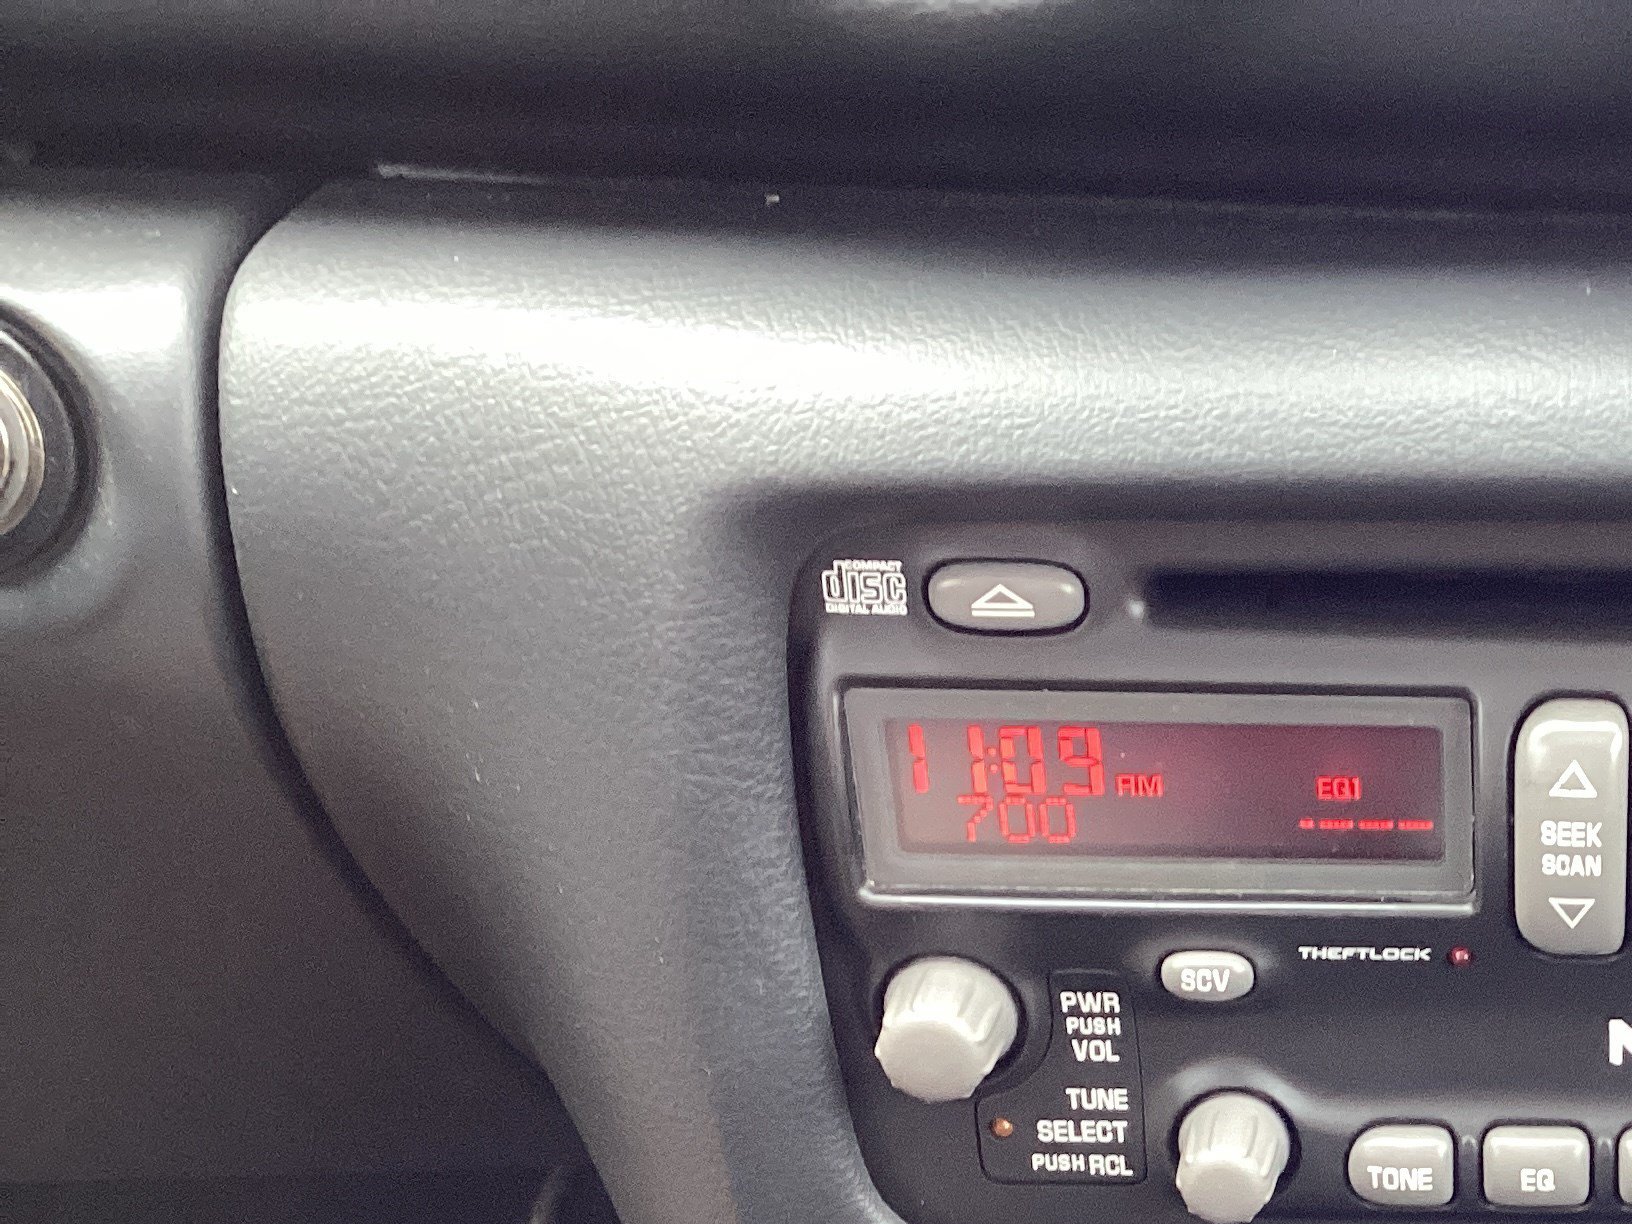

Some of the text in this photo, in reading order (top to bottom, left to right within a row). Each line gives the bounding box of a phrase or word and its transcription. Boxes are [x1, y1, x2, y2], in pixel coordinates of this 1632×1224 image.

[844, 559, 903, 571] COMPACT
[825, 604, 908, 616] DIGITAL AUDIO
[1115, 774, 1164, 798] AM
[1315, 776, 1361, 800] EQ1
[958, 795, 1077, 844] 700
[1541, 821, 1603, 848] SEEK
[1541, 854, 1602, 877] SCAN
[1297, 945, 1431, 963] THEFTLOCK
[1179, 967, 1231, 993] SCV
[1060, 991, 1121, 1015] PWR
[1065, 1016, 1121, 1038] PUSH
[1071, 1038, 1120, 1063] VOL
[1065, 1086, 1129, 1112] TUNE
[1036, 1119, 1128, 1144] SELECT
[1031, 1152, 1134, 1176] PUSH RCL
[1366, 1164, 1434, 1192] TONE
[1519, 1167, 1556, 1193] EQ
